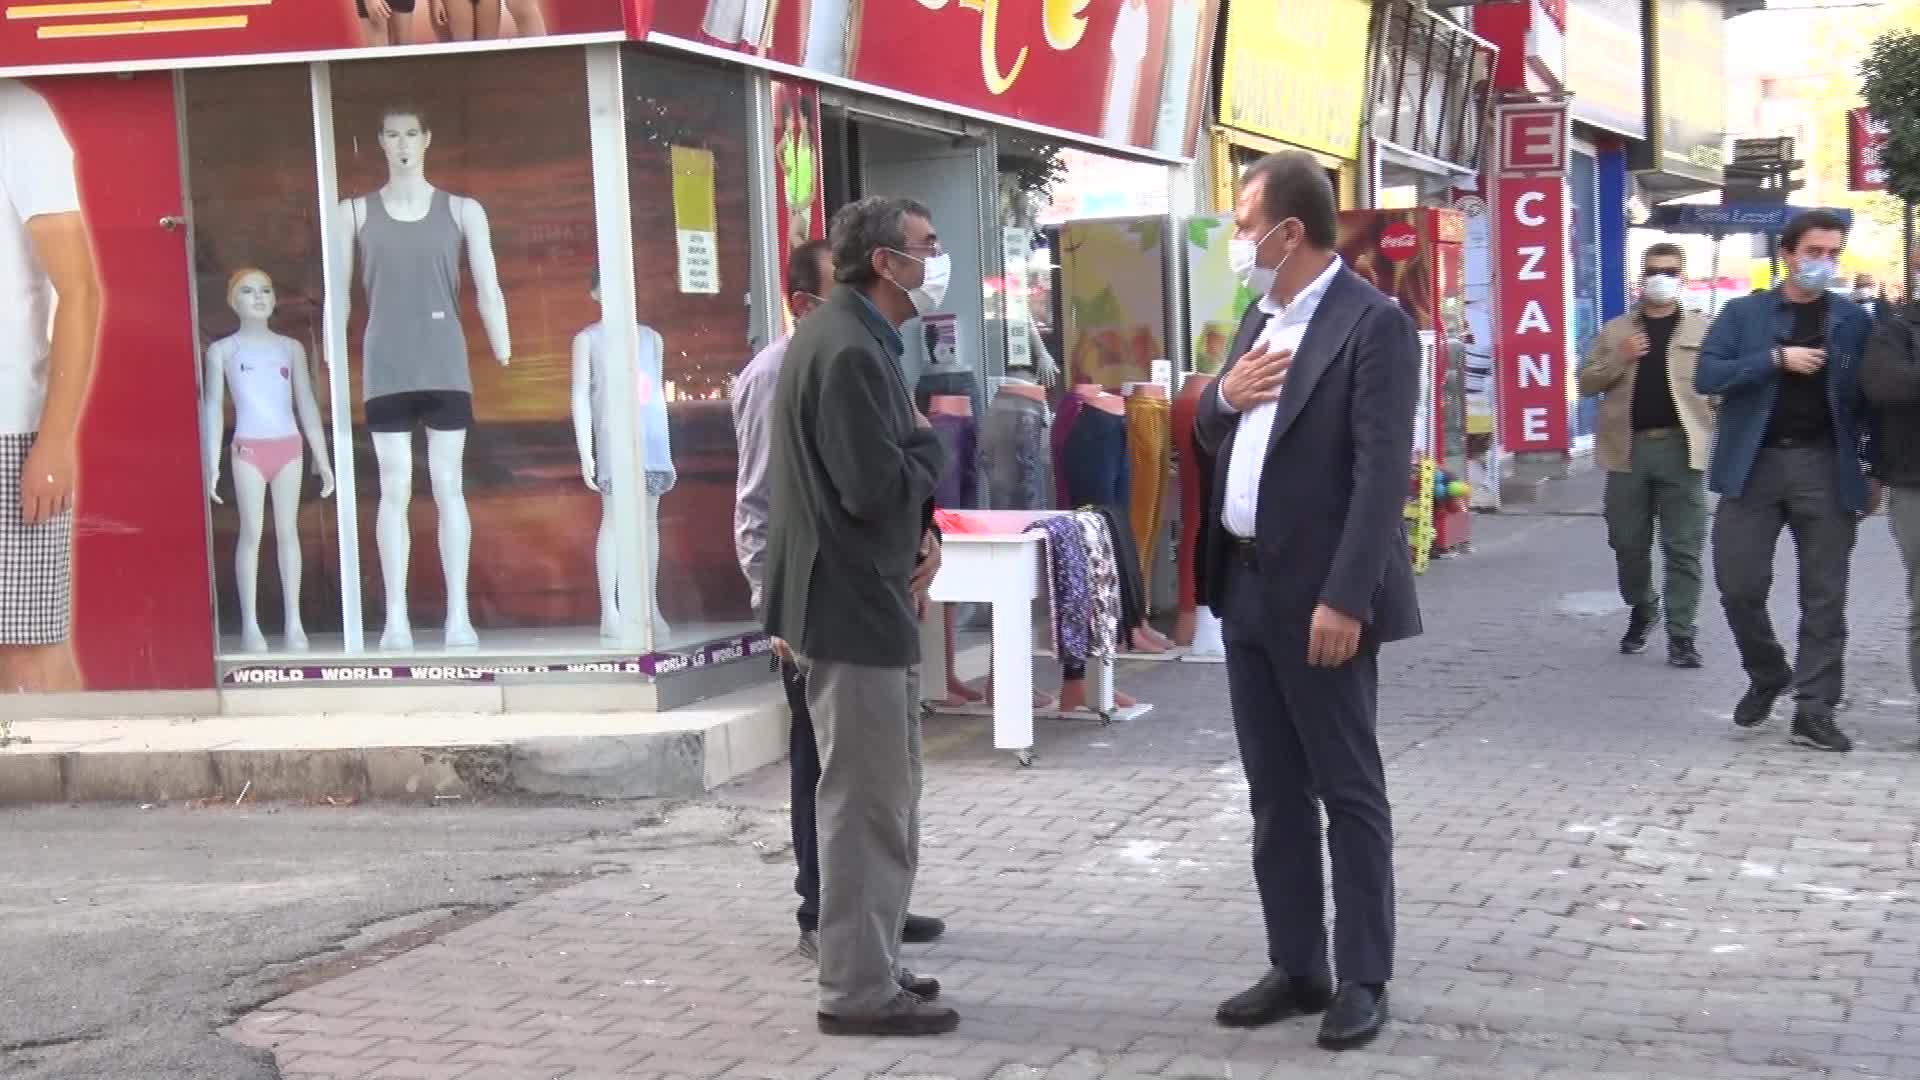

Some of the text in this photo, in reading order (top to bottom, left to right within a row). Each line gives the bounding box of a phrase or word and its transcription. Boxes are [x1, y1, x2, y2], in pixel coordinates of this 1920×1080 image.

[654, 655, 689, 674] WORLD
[711, 646, 744, 664] WORLD
[233, 667, 304, 683] WORLD
[320, 666, 393, 681] WORLD
[410, 665, 483, 680] WORLD
